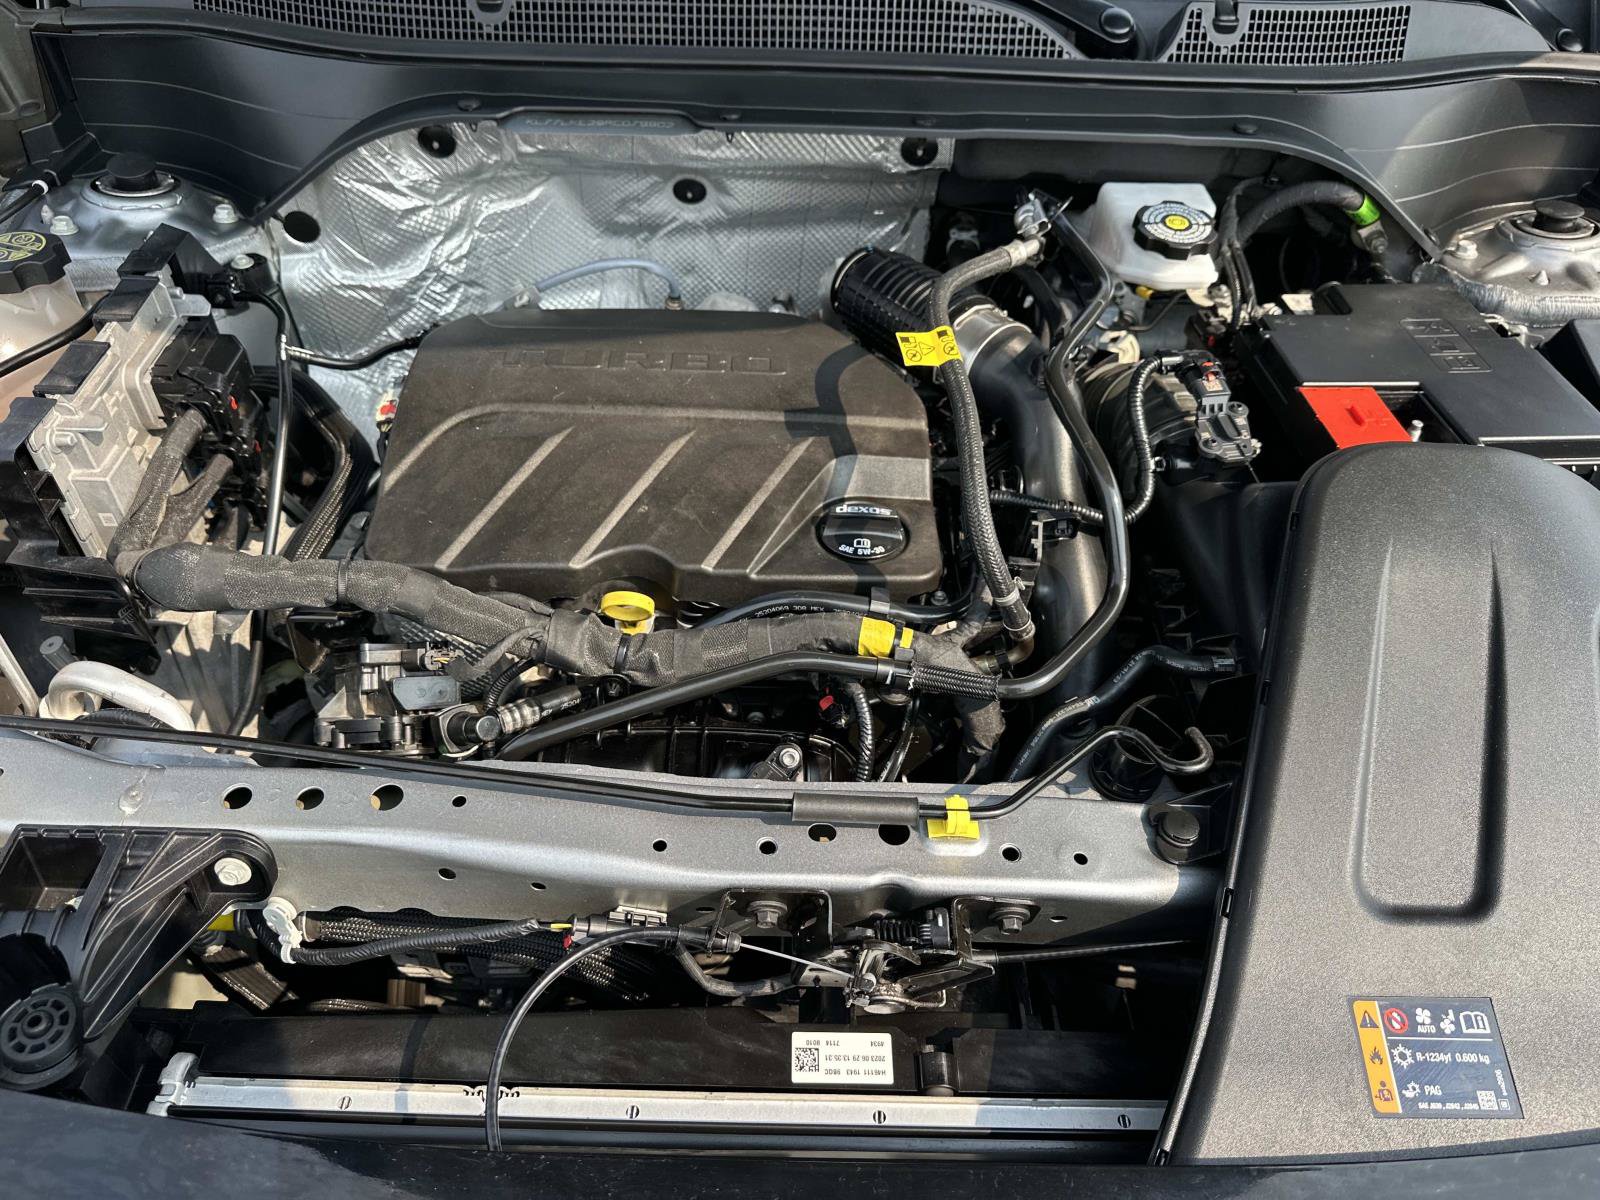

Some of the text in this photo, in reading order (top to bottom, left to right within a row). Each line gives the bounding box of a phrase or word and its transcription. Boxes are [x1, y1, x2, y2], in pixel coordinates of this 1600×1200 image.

[486, 348, 788, 375] TURBO
[836, 504, 893, 516] dexos
[839, 544, 886, 555] SAE 5W-30
[1417, 1025, 1436, 1033] AUTO
[1455, 1053, 1478, 1062] 0.600
[1478, 1053, 1490, 1064] kg
[1424, 1085, 1442, 1095] PAG
